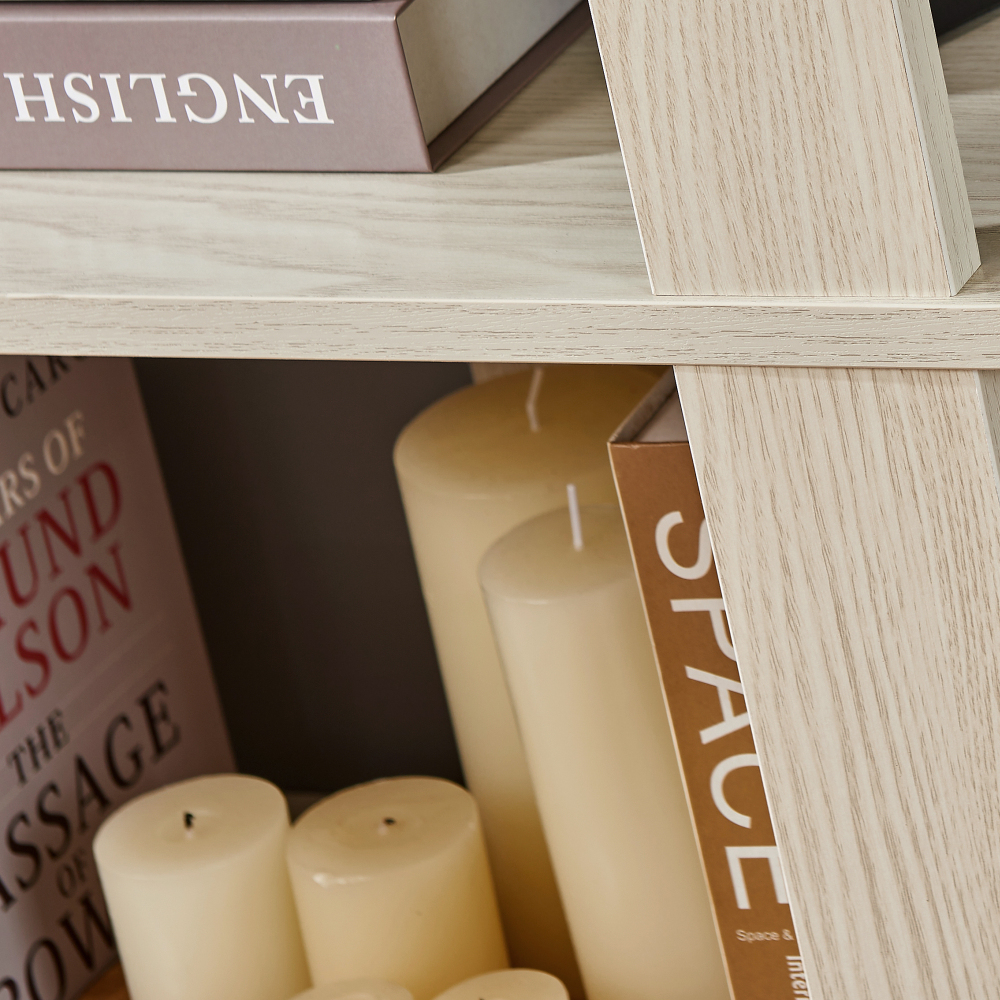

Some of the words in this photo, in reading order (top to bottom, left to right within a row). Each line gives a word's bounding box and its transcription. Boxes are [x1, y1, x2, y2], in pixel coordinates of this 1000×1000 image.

[4, 71, 334, 125] ENGLISH
[1, 356, 90, 419] CAR
[0, 452, 42, 525] RS
[43, 409, 86, 476] OF
[0, 460, 122, 620] UND
[7, 709, 70, 786] THE
[0, 679, 182, 911] SSAGE
[736, 929, 780, 944] Space
